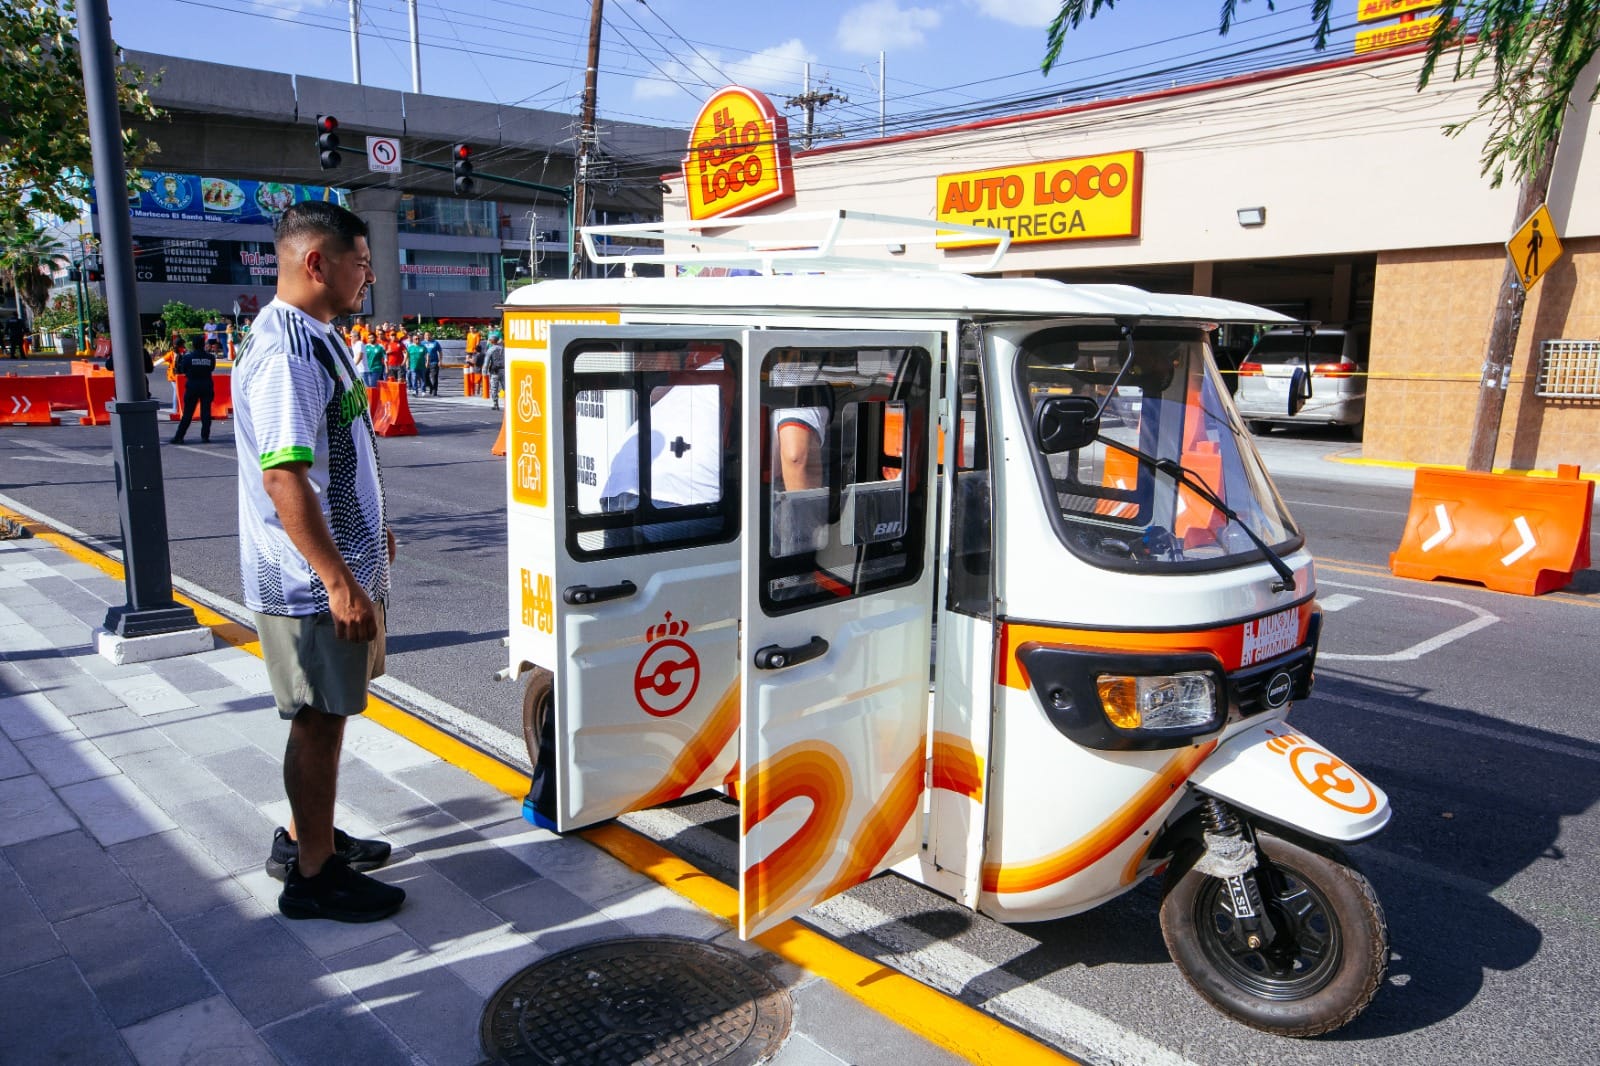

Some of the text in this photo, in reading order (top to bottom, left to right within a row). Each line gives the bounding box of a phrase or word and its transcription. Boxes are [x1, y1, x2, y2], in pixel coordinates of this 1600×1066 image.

[1370, 23, 1431, 47] JUEGOS
[713, 106, 735, 133] EL
[698, 120, 760, 173] POLLO
[700, 154, 762, 205] LOCO
[942, 162, 1128, 214] AUTO LOCO
[508, 319, 532, 341] PARA
